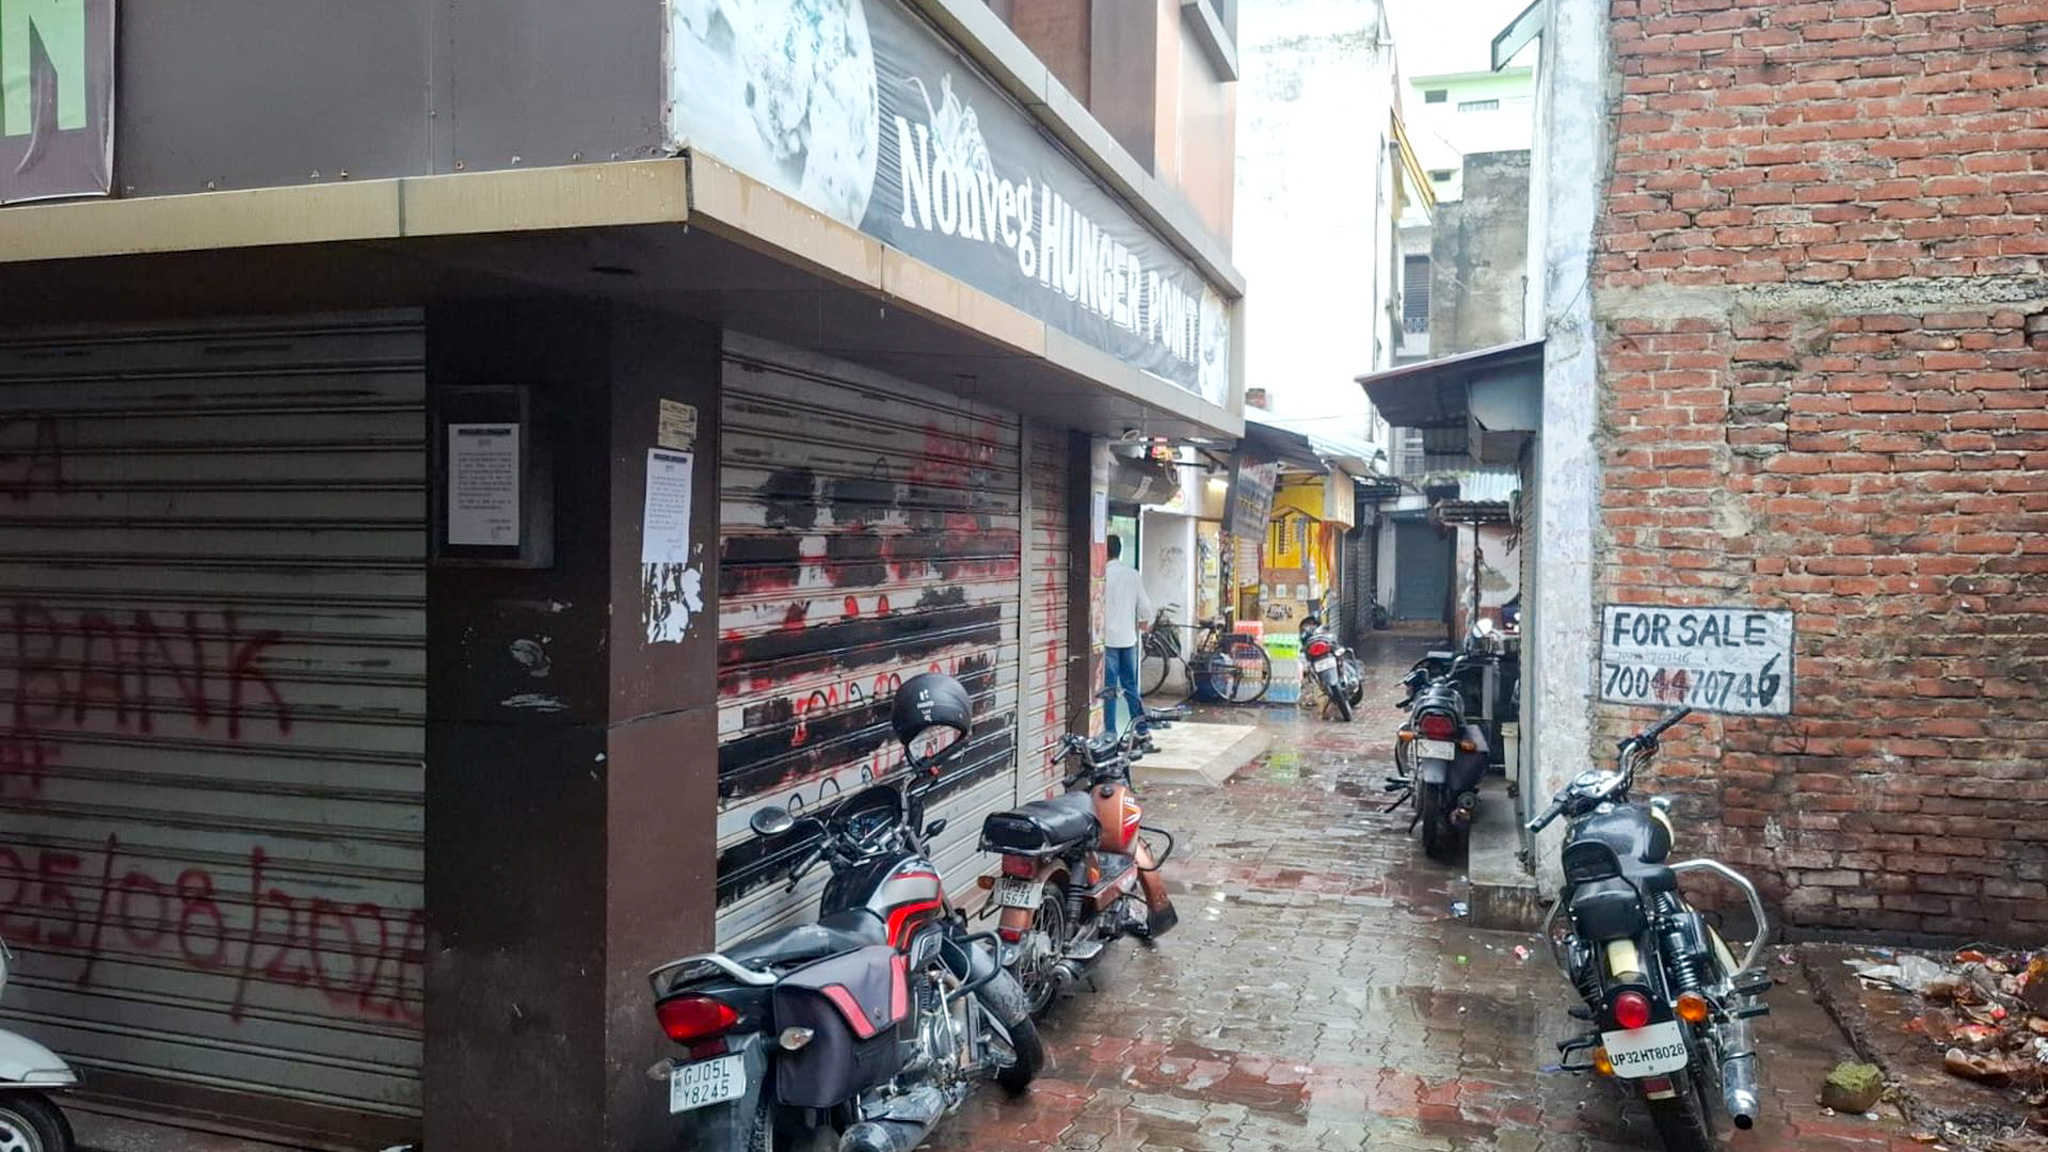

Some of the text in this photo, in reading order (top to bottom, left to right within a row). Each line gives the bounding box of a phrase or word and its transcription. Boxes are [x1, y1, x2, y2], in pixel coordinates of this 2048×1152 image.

[894, 115, 1200, 364] Nonveg HUNGER POINT
[1612, 612, 1767, 648] FOR SALE
[1604, 652, 1781, 707] 7004470746
[1609, 1043, 1685, 1067] UP32HT8028
[684, 1079, 730, 1107] Y8245
